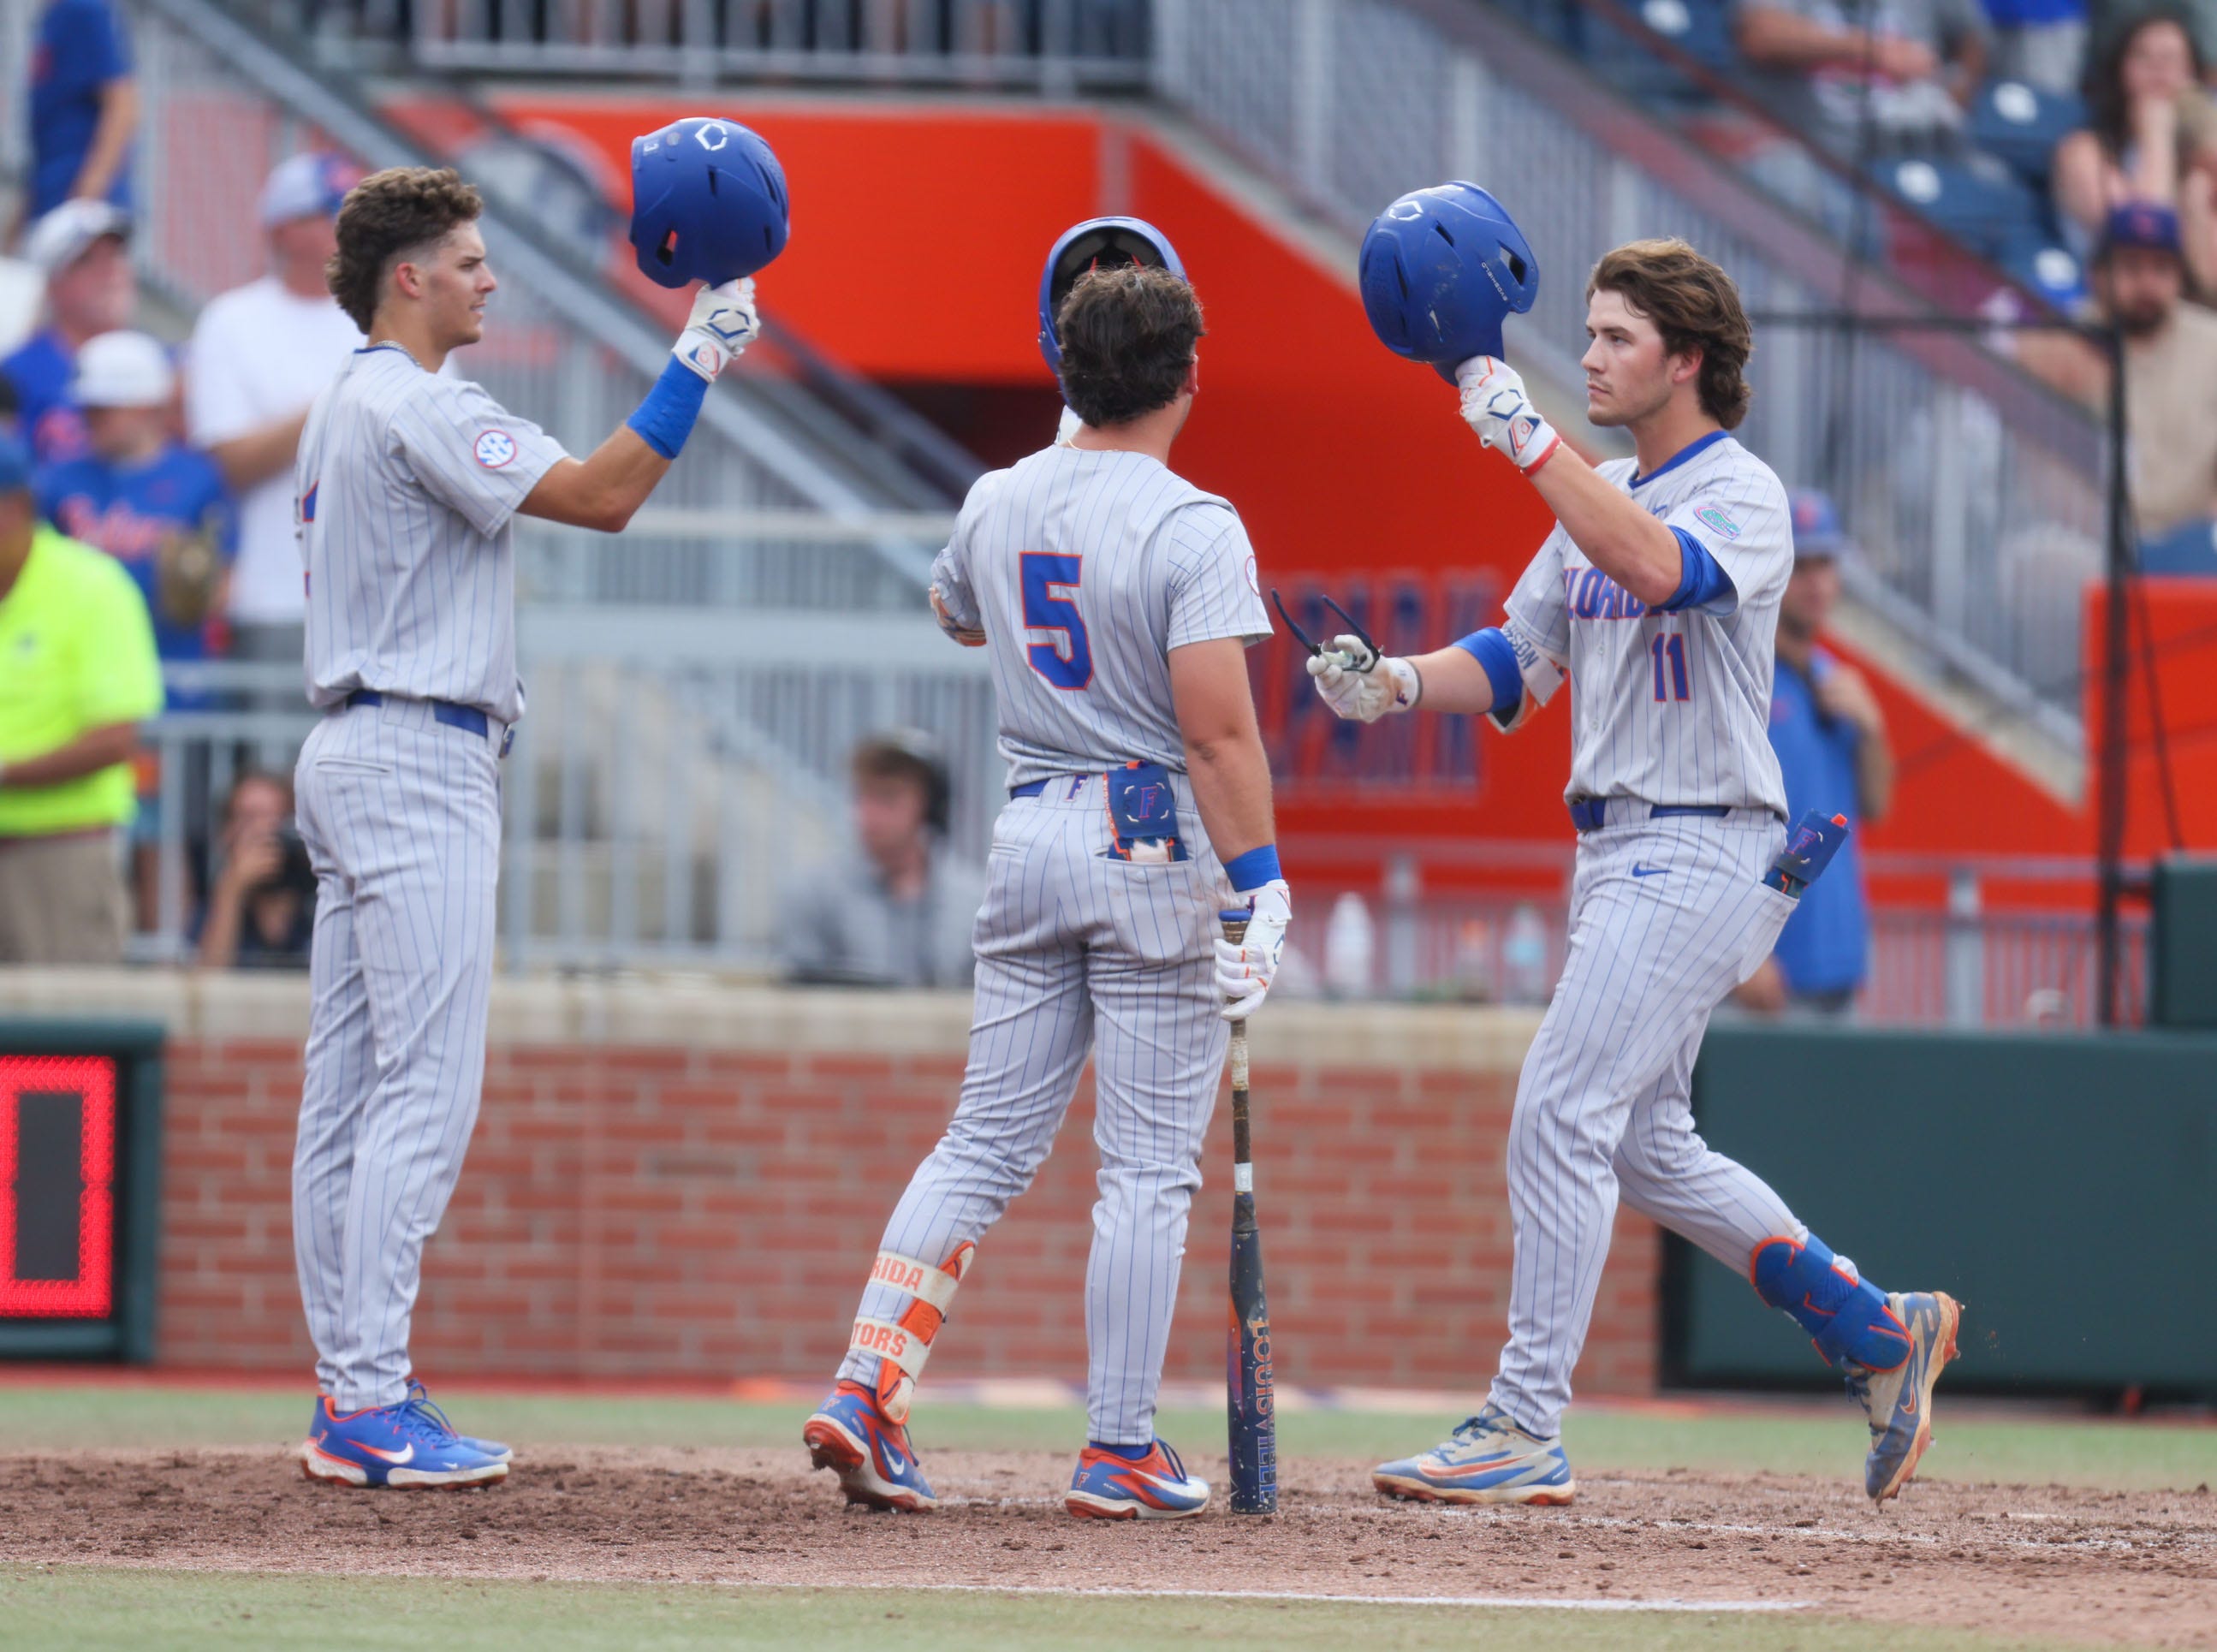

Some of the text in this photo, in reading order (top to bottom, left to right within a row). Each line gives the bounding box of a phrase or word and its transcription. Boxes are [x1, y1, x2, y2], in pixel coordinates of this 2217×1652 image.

[1563, 566, 1678, 621] LORI
[1019, 550, 1094, 691] 5
[1651, 633, 1691, 703] 11
[1064, 773, 1090, 802] F
[1138, 785, 1158, 819] F
[1785, 826, 1817, 855] F
[1251, 1319, 1278, 1502] LOUISVILLE
[1076, 1471, 1091, 1489] F
